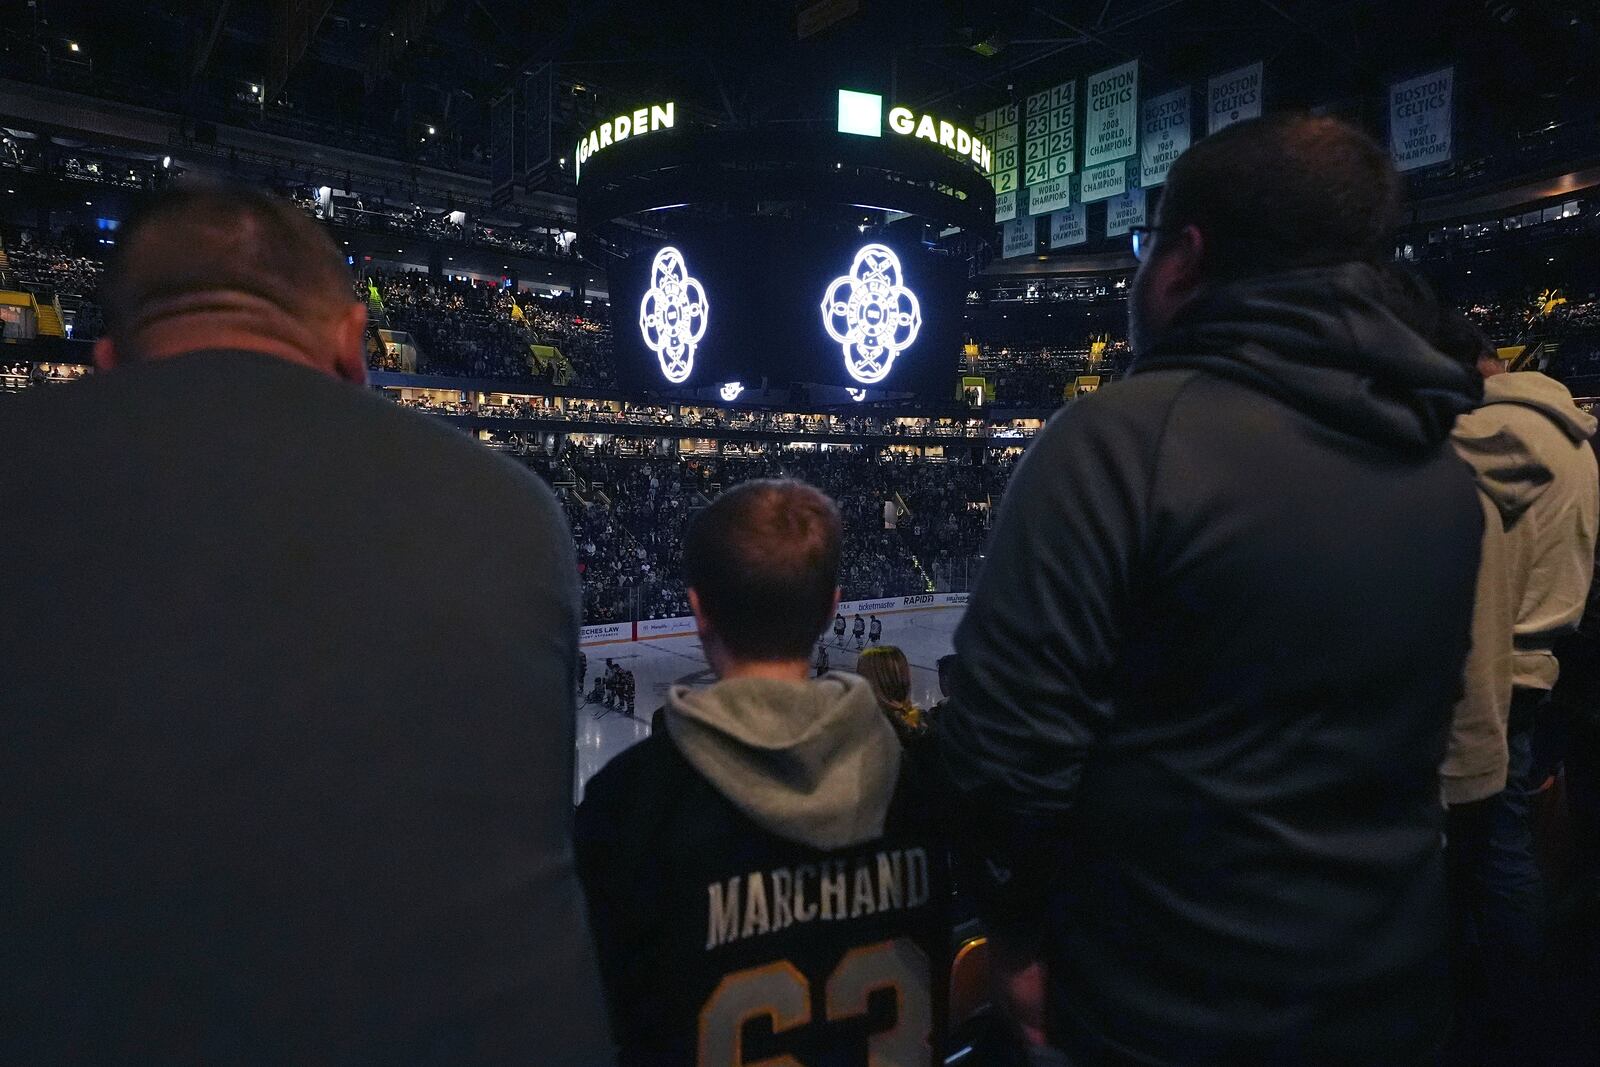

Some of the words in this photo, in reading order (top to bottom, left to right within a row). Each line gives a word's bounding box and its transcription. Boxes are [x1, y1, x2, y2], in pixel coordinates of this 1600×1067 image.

[1092, 71, 1134, 97] BOSTON
[1213, 73, 1258, 101] BOSTON
[1395, 80, 1447, 105] BOSTON
[1028, 93, 1048, 114] 22
[1055, 84, 1072, 105] 14
[1093, 87, 1132, 111] CELTICS
[1145, 97, 1186, 121] BOSTON
[1215, 90, 1256, 114] CELTICS
[1397, 94, 1445, 118] CELTICS
[1000, 106, 1015, 124] 16
[1028, 115, 1047, 137] 23
[1054, 107, 1071, 128] 15
[1103, 119, 1119, 131] 2008
[1146, 112, 1185, 134] CELTICS
[580, 102, 674, 164] GARDEN
[889, 107, 991, 173] GARDEN
[1099, 128, 1124, 143] WORLD
[1404, 134, 1436, 150] WORLD
[1028, 138, 1046, 160] 21
[1052, 129, 1072, 153] 25
[1090, 137, 1132, 156] CHAMPIONS
[1158, 140, 1174, 153] 1969
[999, 150, 1015, 169] 18
[1153, 150, 1179, 164] WORLD
[1027, 162, 1046, 184] 24
[1056, 156, 1067, 174] 6
[1092, 168, 1116, 182] WORLD
[1144, 162, 1170, 176] CHAMP
[1001, 173, 1011, 191] 2
[1038, 183, 1060, 195] WORLD
[1032, 190, 1067, 206] CHAMPIONS
[858, 602, 895, 611] ticketmaster
[705, 847, 930, 950] MARCHAND
